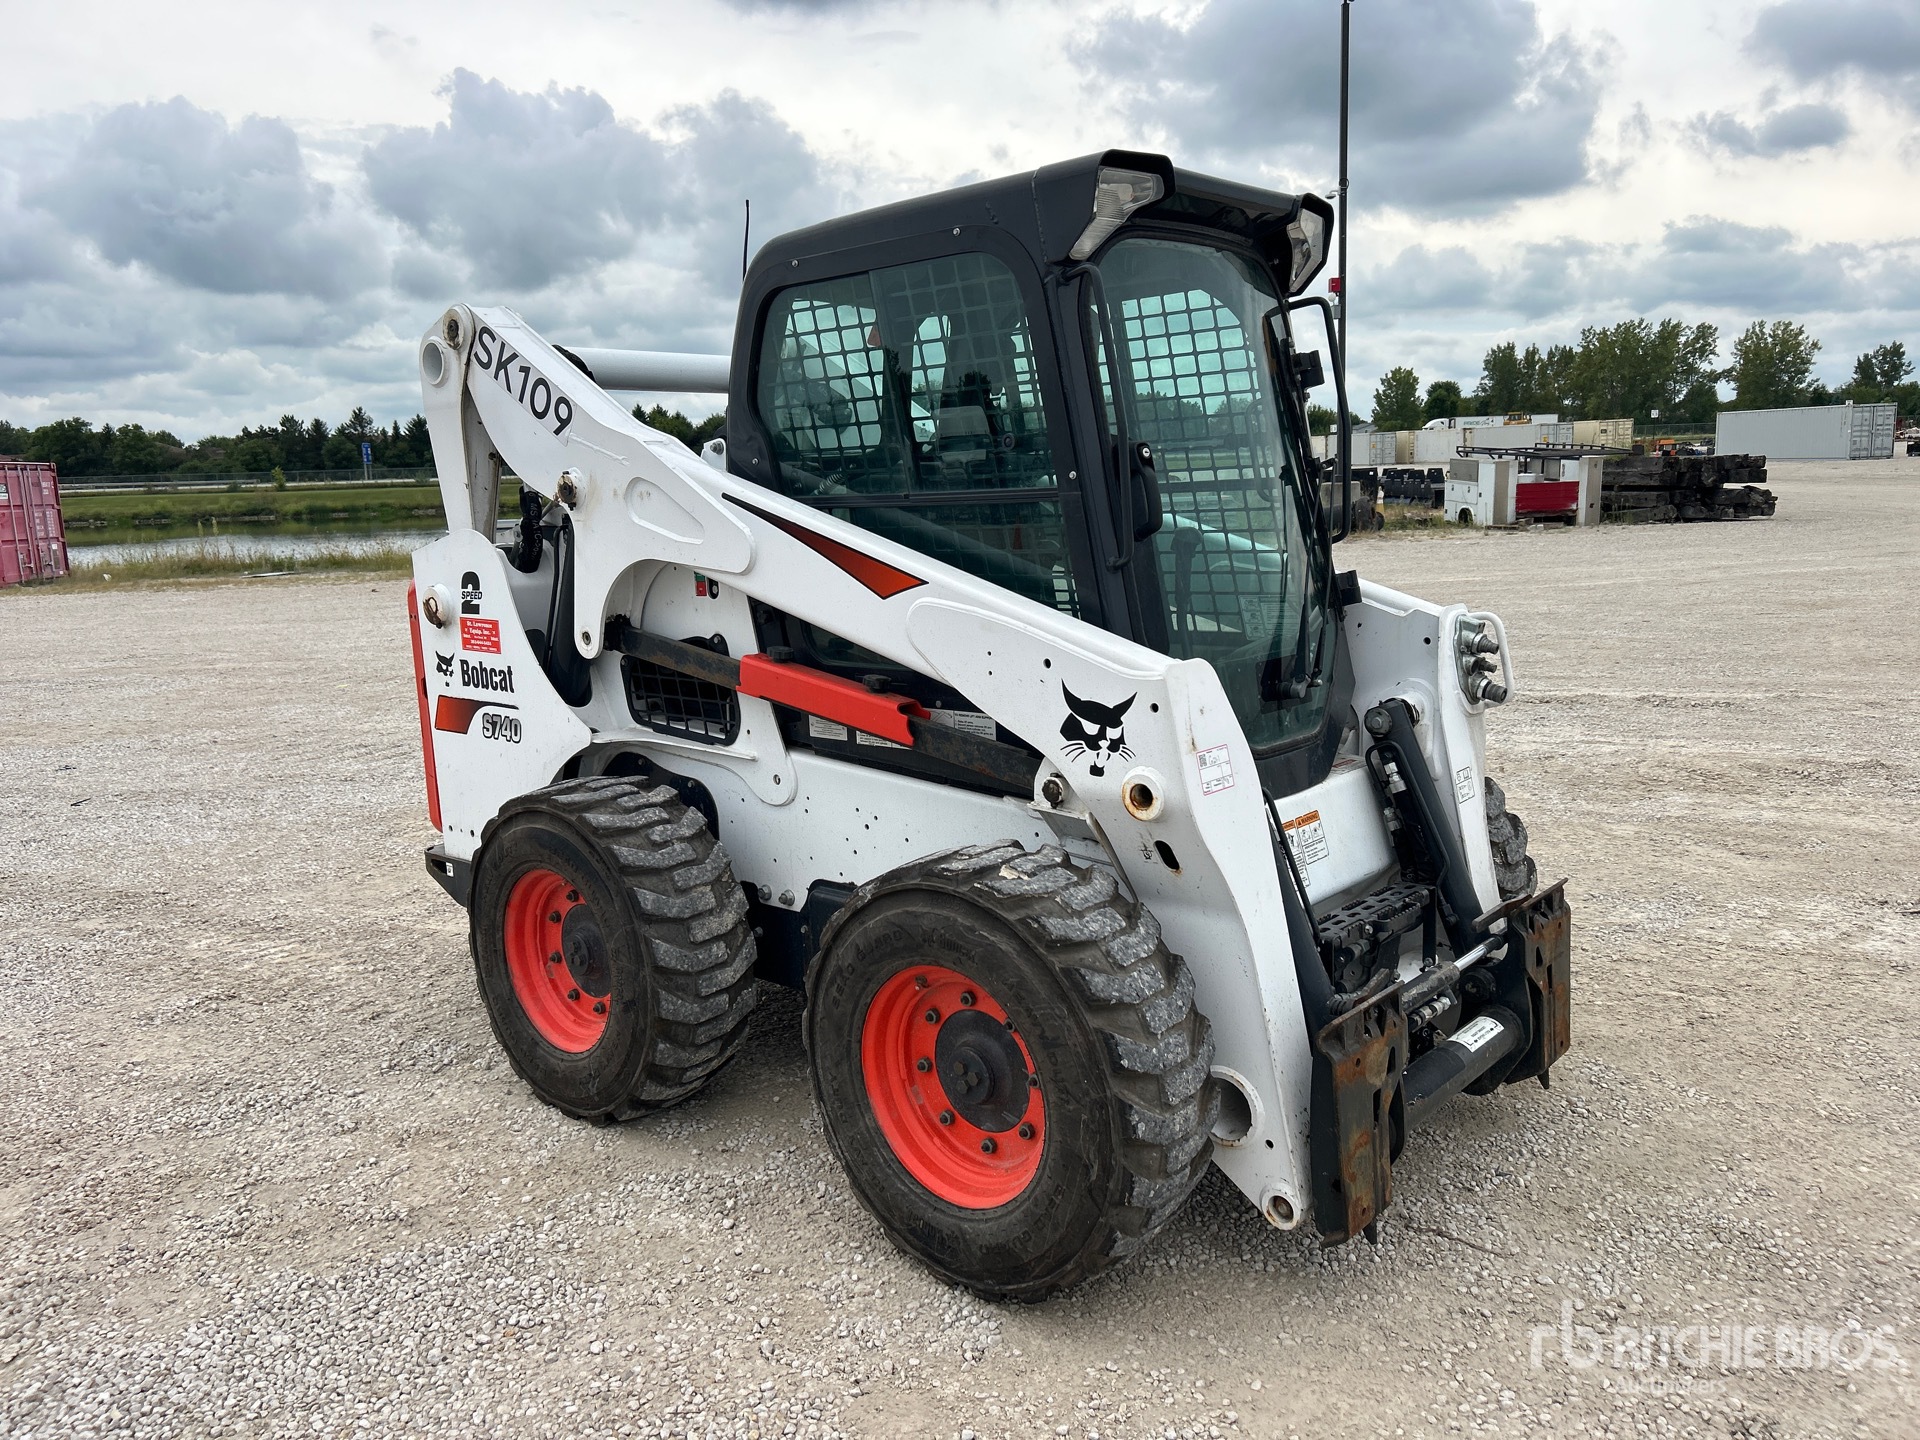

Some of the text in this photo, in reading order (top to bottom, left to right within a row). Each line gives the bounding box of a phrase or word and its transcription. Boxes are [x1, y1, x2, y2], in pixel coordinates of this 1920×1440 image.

[474, 326, 574, 436] SK109
[461, 571, 481, 614] 2
[461, 590, 482, 600] SPEED
[459, 659, 515, 693] Bobcat
[482, 712, 522, 744] S740
